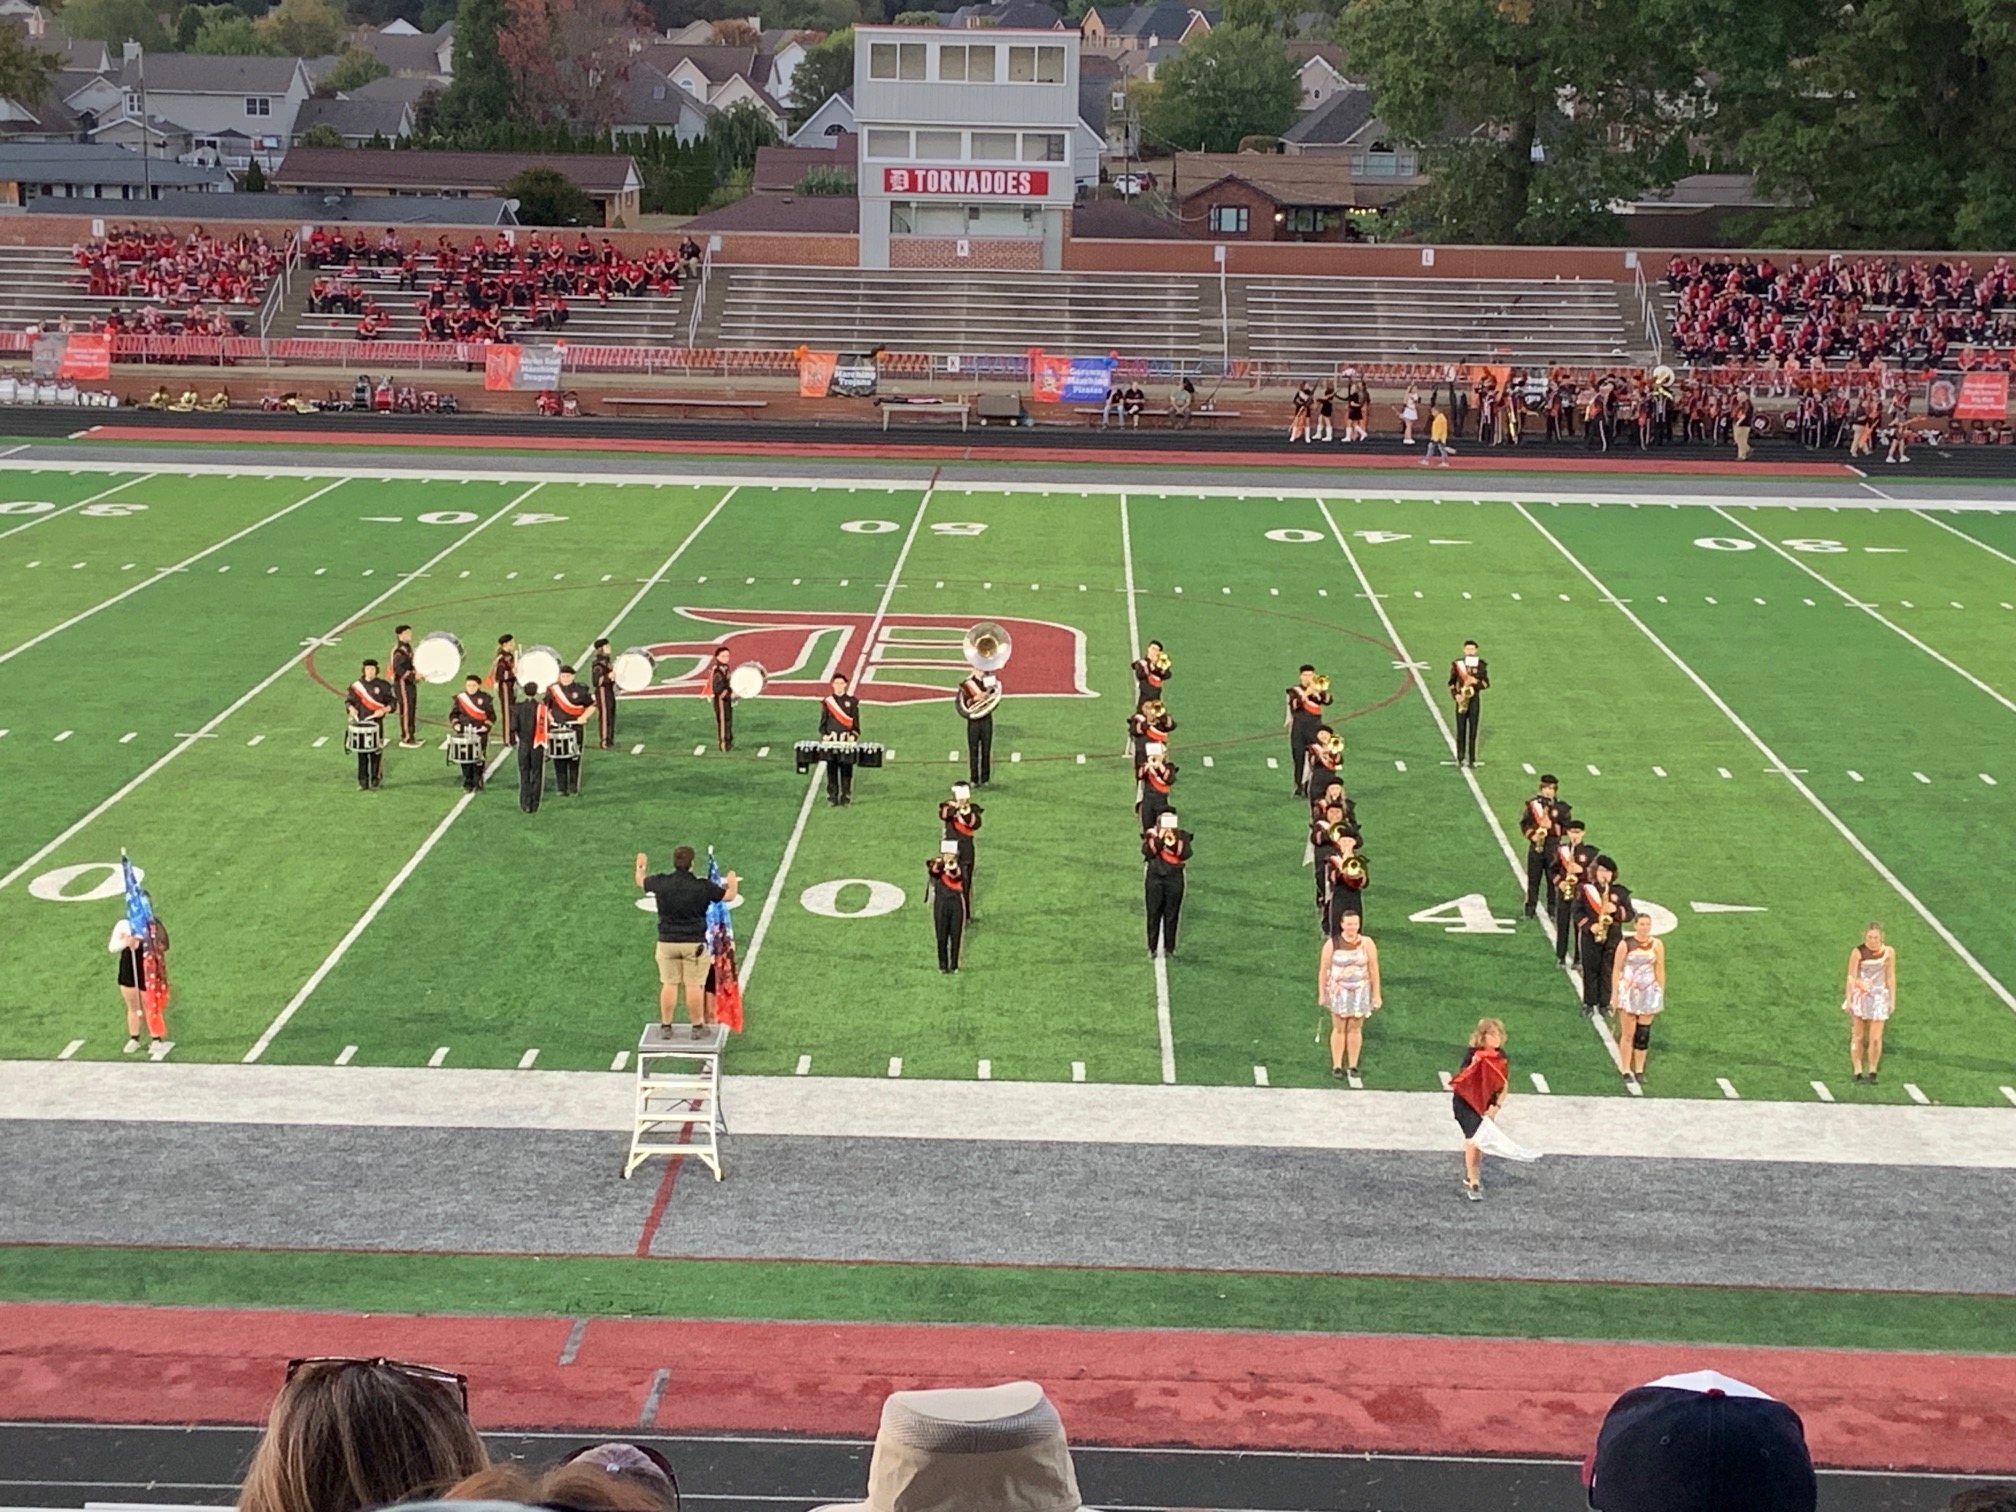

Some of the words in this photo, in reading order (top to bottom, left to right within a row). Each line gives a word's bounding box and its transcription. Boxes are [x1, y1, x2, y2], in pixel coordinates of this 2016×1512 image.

[915, 169, 1031, 195] TORNADOES
[834, 371, 877, 380] Marching
[838, 378, 872, 387] Trojans
[1073, 386, 1103, 394] Pirates
